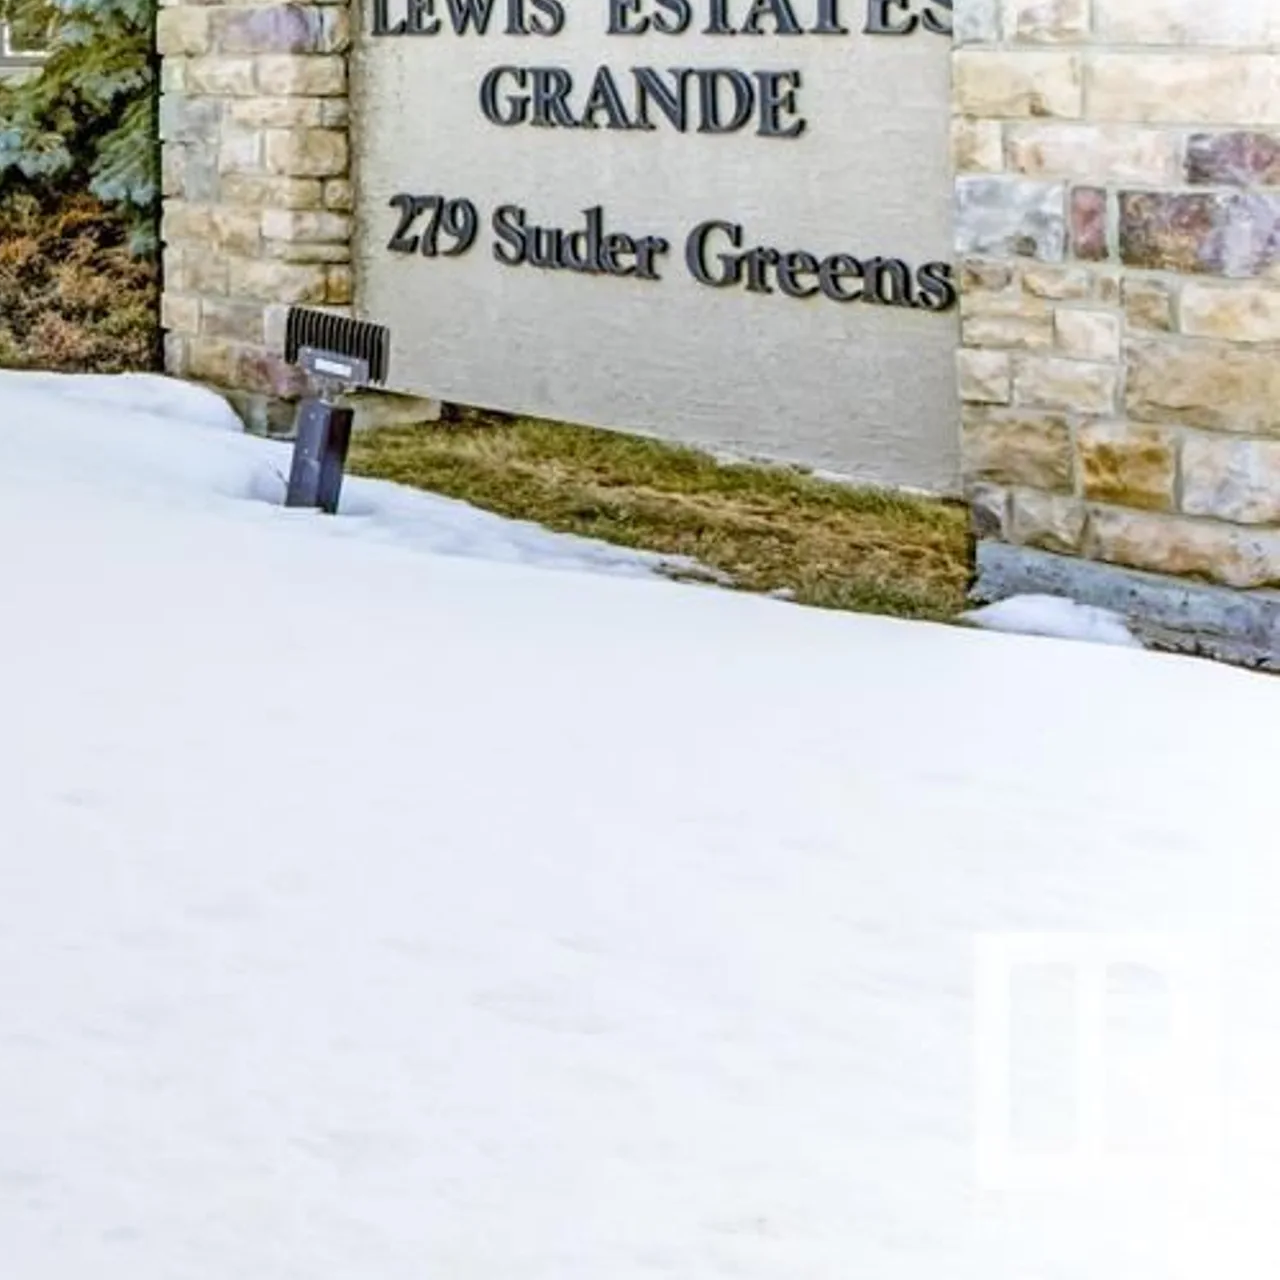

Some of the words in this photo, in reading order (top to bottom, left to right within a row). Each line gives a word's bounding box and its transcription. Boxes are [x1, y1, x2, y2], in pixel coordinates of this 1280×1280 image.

[479, 65, 808, 139] GRANDE
[387, 194, 478, 257] 279
[491, 204, 669, 280] Suder
[685, 220, 958, 311] Greens
